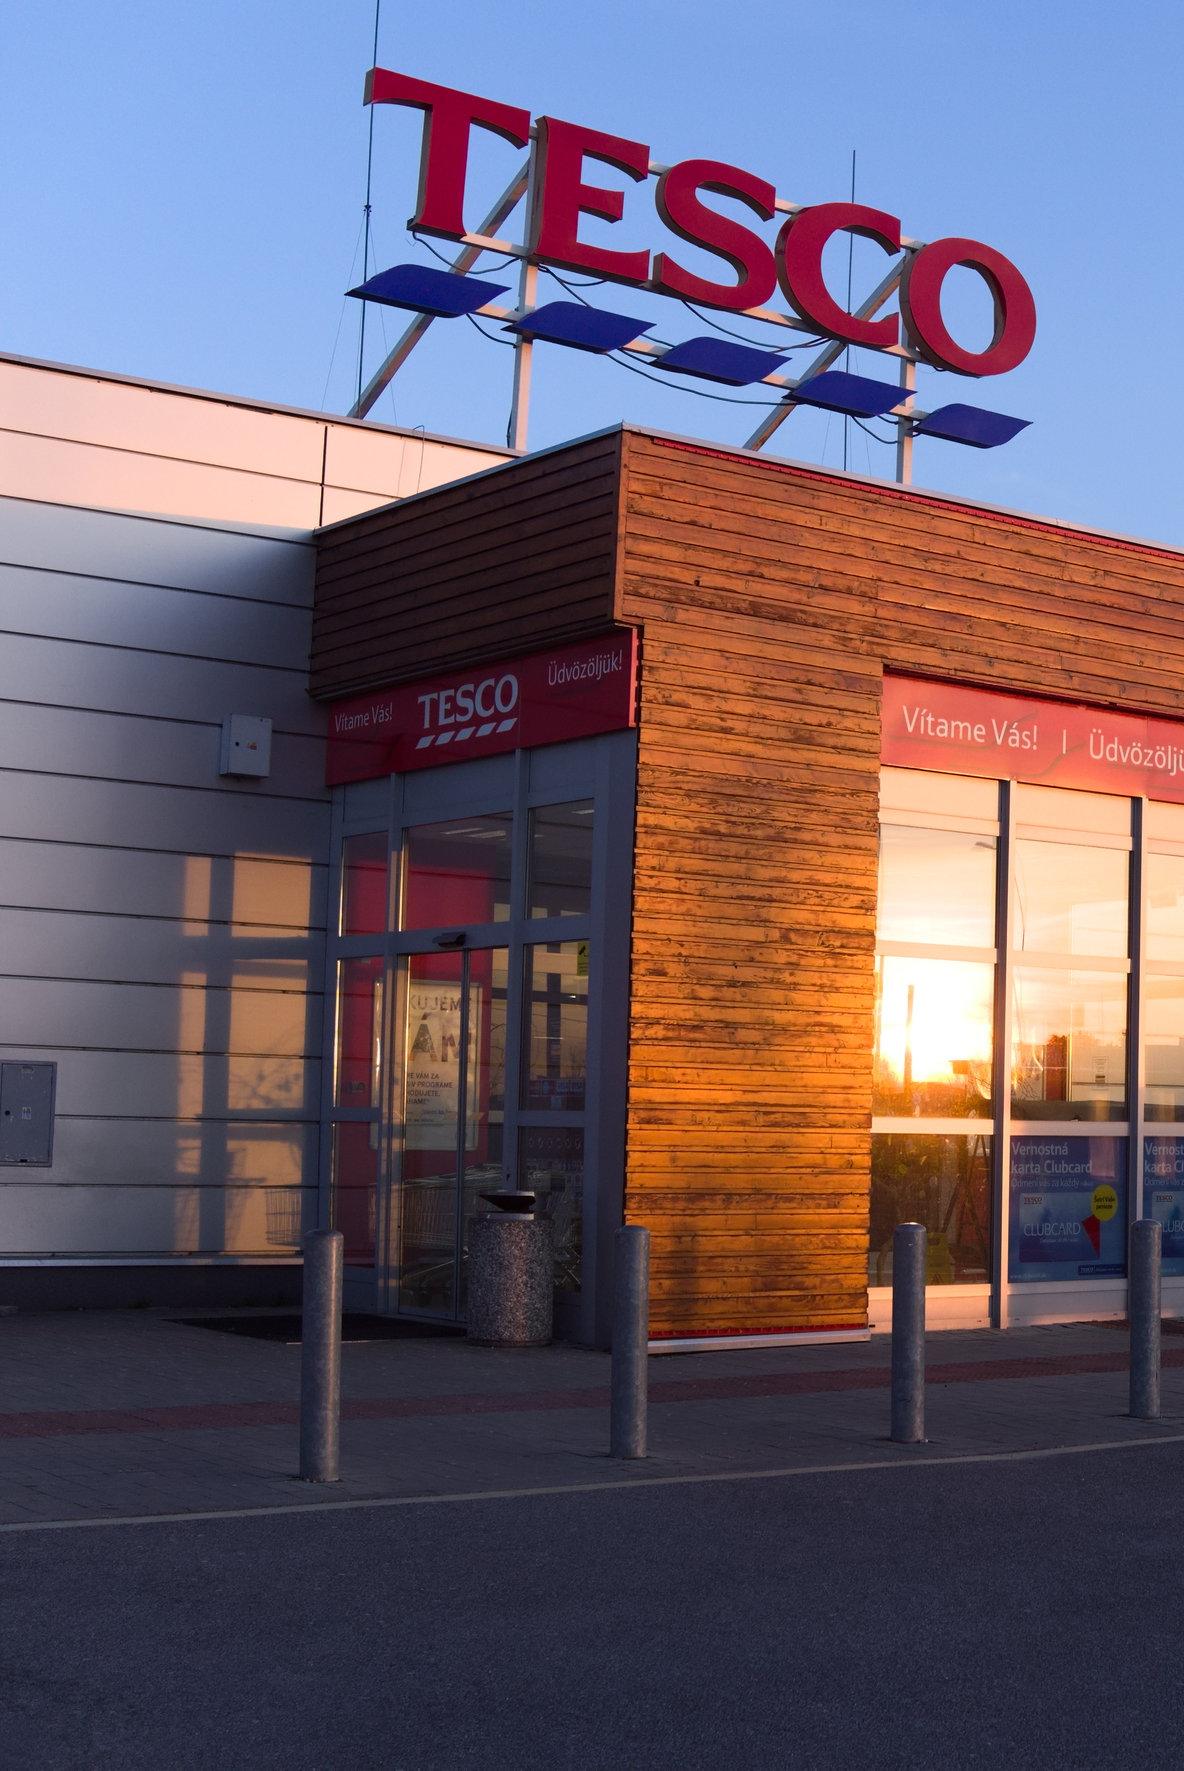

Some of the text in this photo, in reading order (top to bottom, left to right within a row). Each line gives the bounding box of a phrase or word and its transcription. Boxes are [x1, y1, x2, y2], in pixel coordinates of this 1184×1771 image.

[363, 66, 1036, 378] TESCO
[548, 649, 623, 686] Üdvözöljük!
[417, 674, 519, 729] TESCO
[335, 702, 393, 733] Vítame Vás!
[902, 705, 986, 743] Vítame
[992, 719, 1038, 751] Vás!
[1011, 1142, 1069, 1155] Vernostná
[1011, 1160, 1093, 1174] karta Clubcard
[1144, 1160, 1172, 1173] karta
[1023, 1222, 1081, 1236] CLUBCARD
